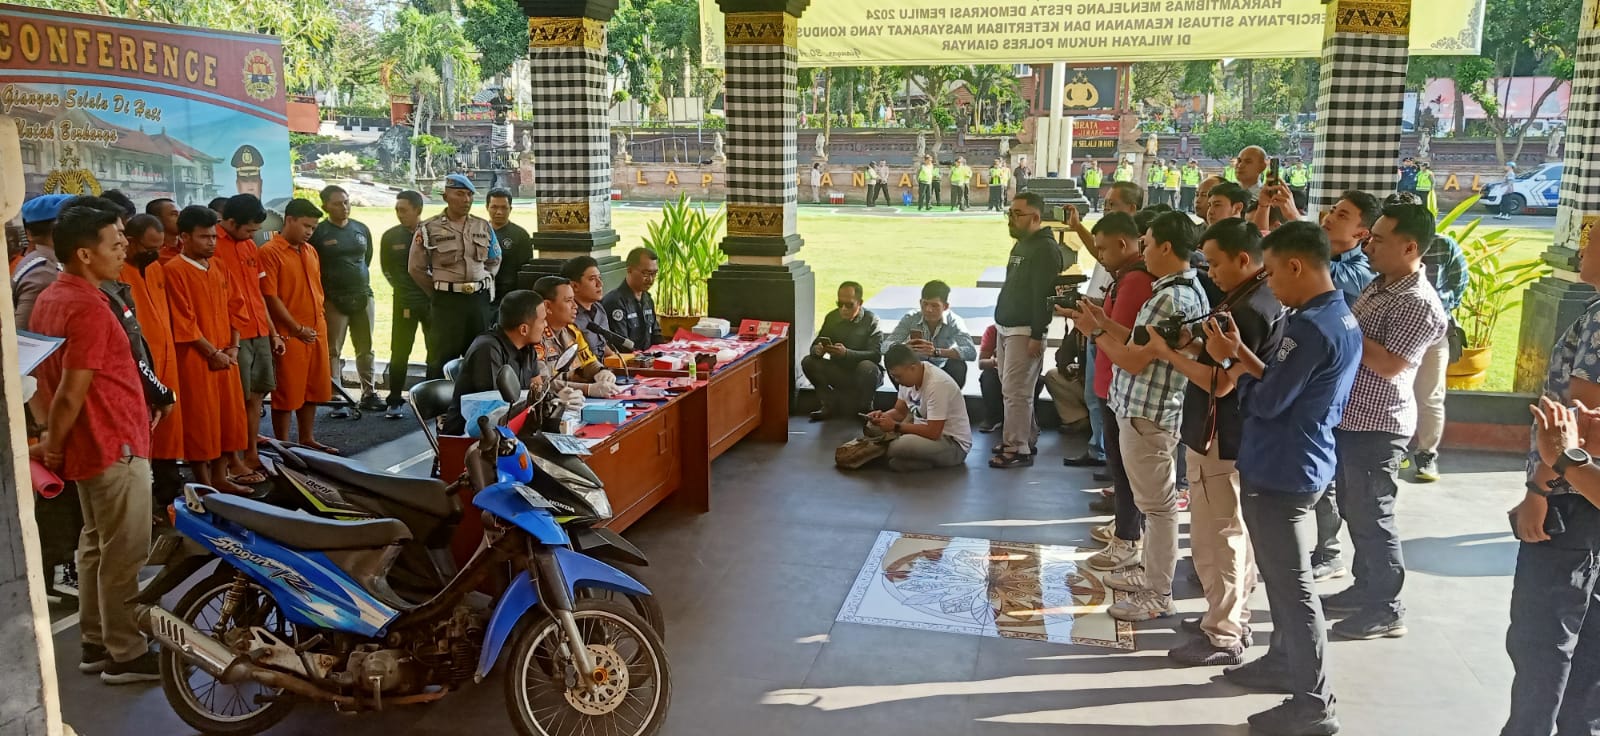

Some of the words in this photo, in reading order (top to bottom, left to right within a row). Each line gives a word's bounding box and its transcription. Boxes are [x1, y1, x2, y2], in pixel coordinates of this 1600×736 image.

[0, 22, 218, 88] CONFERENCE
[2, 84, 60, 114] Gianyar
[113, 94, 129, 114] Di
